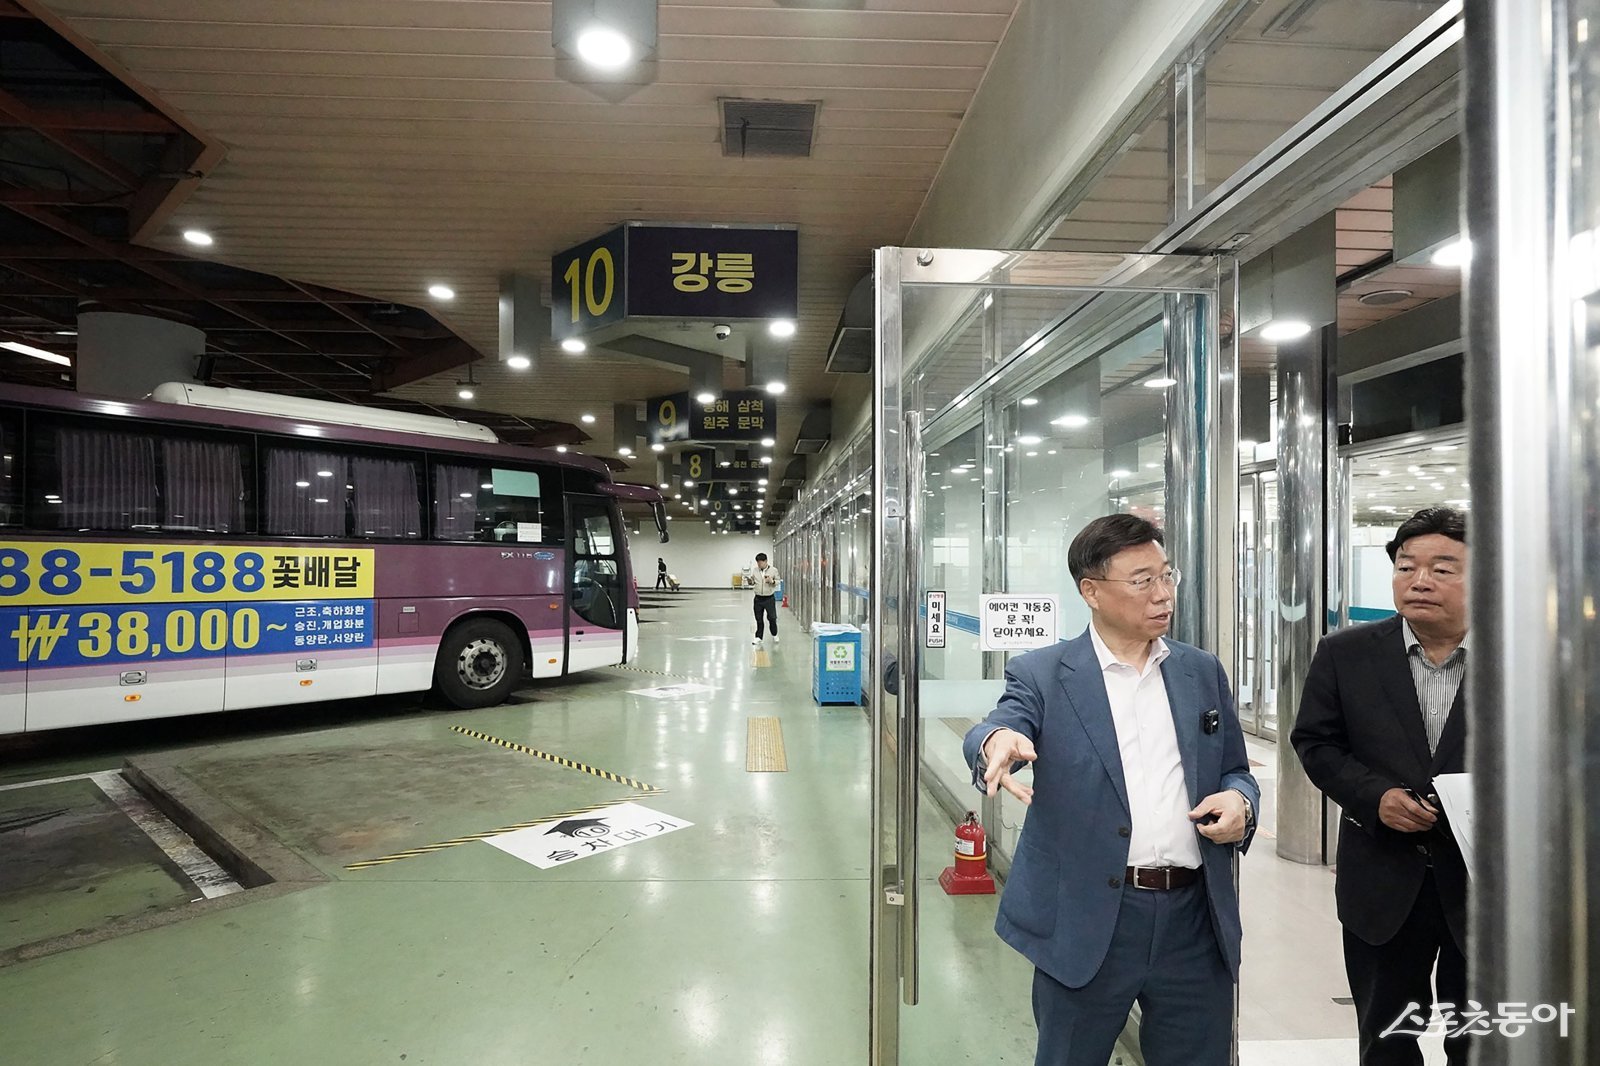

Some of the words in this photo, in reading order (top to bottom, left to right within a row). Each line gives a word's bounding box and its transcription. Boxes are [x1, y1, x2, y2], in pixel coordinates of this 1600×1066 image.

[671, 252, 755, 293] 강릉
[563, 247, 614, 324] 10
[737, 399, 764, 413] 삼척
[658, 400, 677, 438] 9
[703, 416, 729, 430] 원주
[737, 416, 764, 430] 문막
[689, 454, 702, 478] 8
[0, 548, 266, 596] 88-5188
[272, 555, 361, 589] 꽃배달
[294, 605, 365, 617] 근조,축하화환
[988, 602, 1019, 613] 에어컨
[1023, 602, 1052, 612] 가동중
[931, 601, 941, 634] 미세요
[1007, 614, 1016, 625] 문
[1021, 614, 1035, 625] 꼭!
[294, 619, 365, 631] 승진,개업화분
[294, 632, 365, 646] 동양란,서양란
[992, 627, 1049, 638] 닫아주세요.
